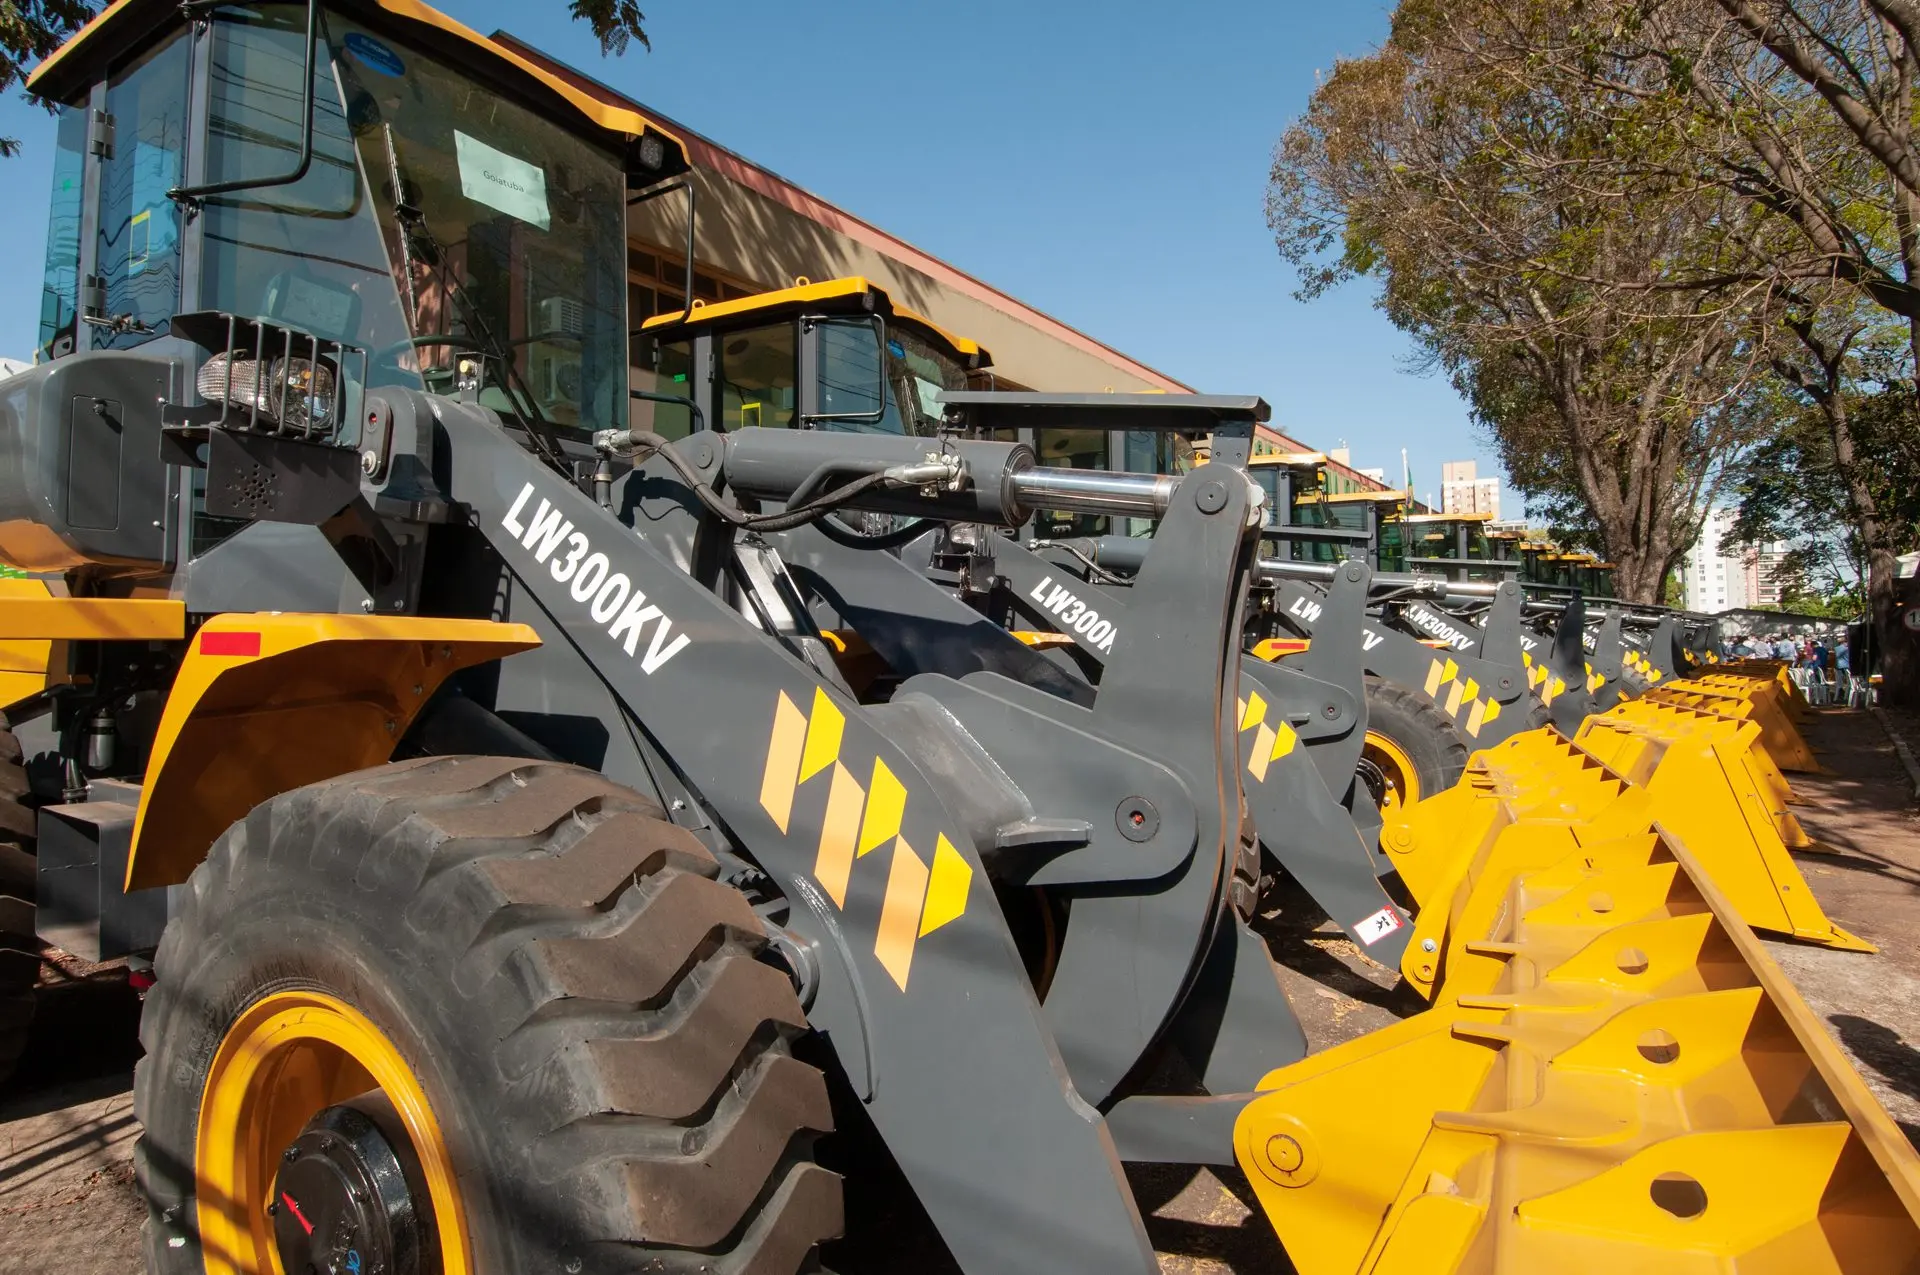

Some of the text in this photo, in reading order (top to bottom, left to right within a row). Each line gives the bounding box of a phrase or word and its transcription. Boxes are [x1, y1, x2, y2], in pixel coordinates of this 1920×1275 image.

[483, 170, 524, 192] Goiatuba
[502, 482, 691, 675] LW300KV
[1030, 576, 1117, 655] LW300
[1405, 605, 1475, 651] LW300KV
